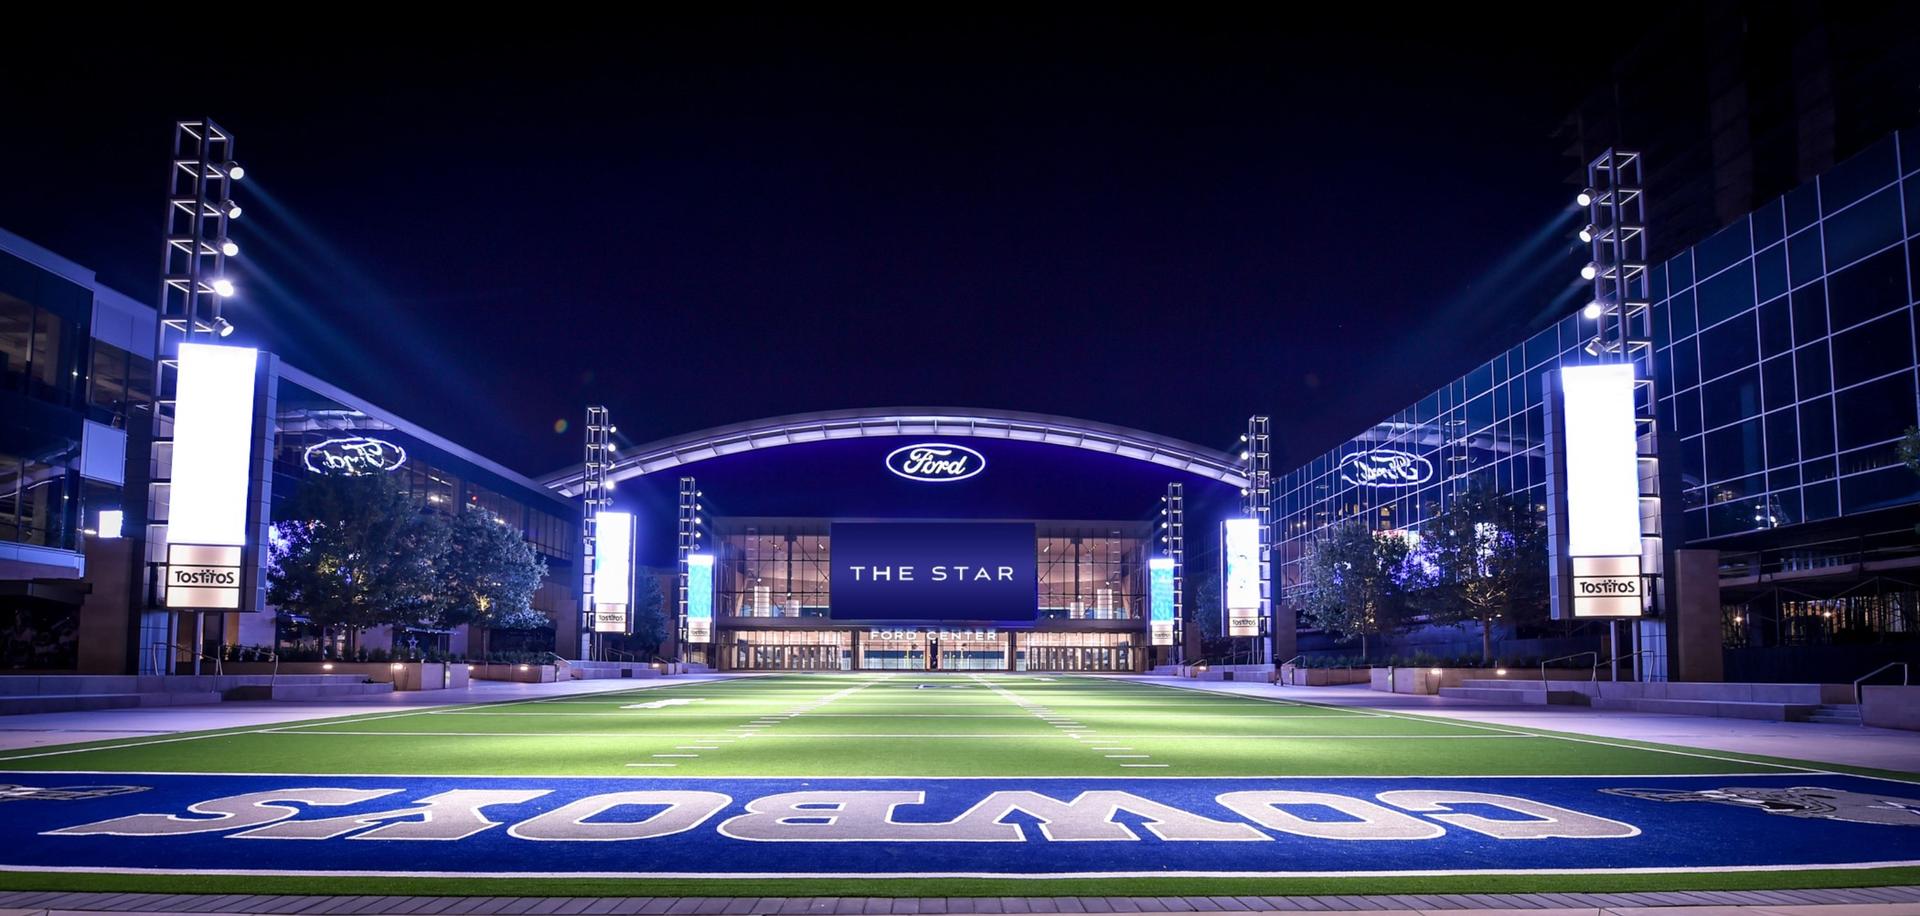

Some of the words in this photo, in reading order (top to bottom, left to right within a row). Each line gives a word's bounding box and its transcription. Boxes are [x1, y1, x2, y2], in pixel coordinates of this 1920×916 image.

[903, 448, 968, 475] Ford
[850, 566, 914, 581] THE
[931, 566, 1014, 581] STAR
[870, 630, 916, 640] FORD
[926, 630, 996, 640] CENTER
[37, 787, 1641, 840] COWBOYS
